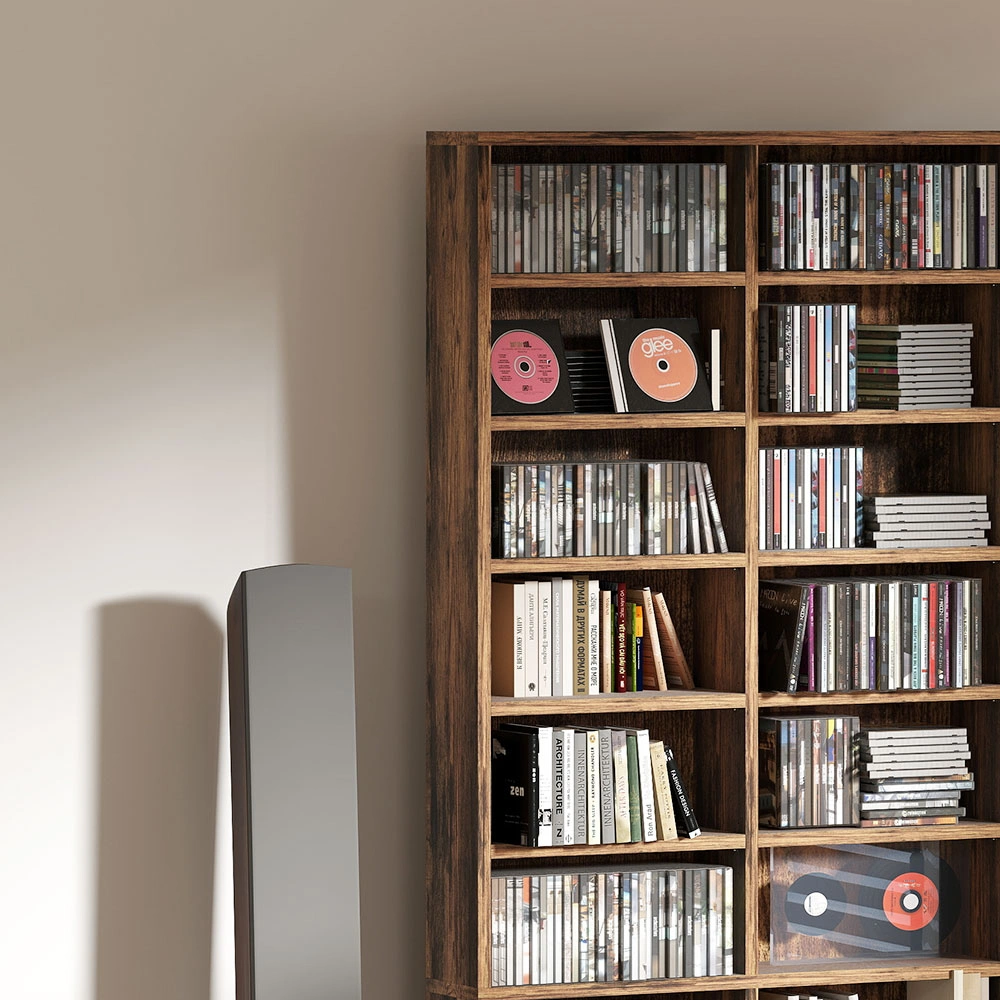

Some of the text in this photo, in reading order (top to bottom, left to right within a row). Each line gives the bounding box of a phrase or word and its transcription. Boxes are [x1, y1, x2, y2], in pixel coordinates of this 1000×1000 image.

[641, 338, 674, 358] glee
[576, 580, 587, 606] ДУМАЙ
[576, 616, 586, 644] ДРУГИХ
[590, 625, 598, 654] РАССКАЖИ
[578, 646, 586, 686] ФОРМАТАХ
[590, 655, 598, 666] МНЕ
[590, 672, 598, 686] МОРЕ
[510, 786, 525, 797] zen
[601, 736, 612, 827] INNENARCHITEKTUR
[670, 770, 691, 817] FASHION DESIGN
